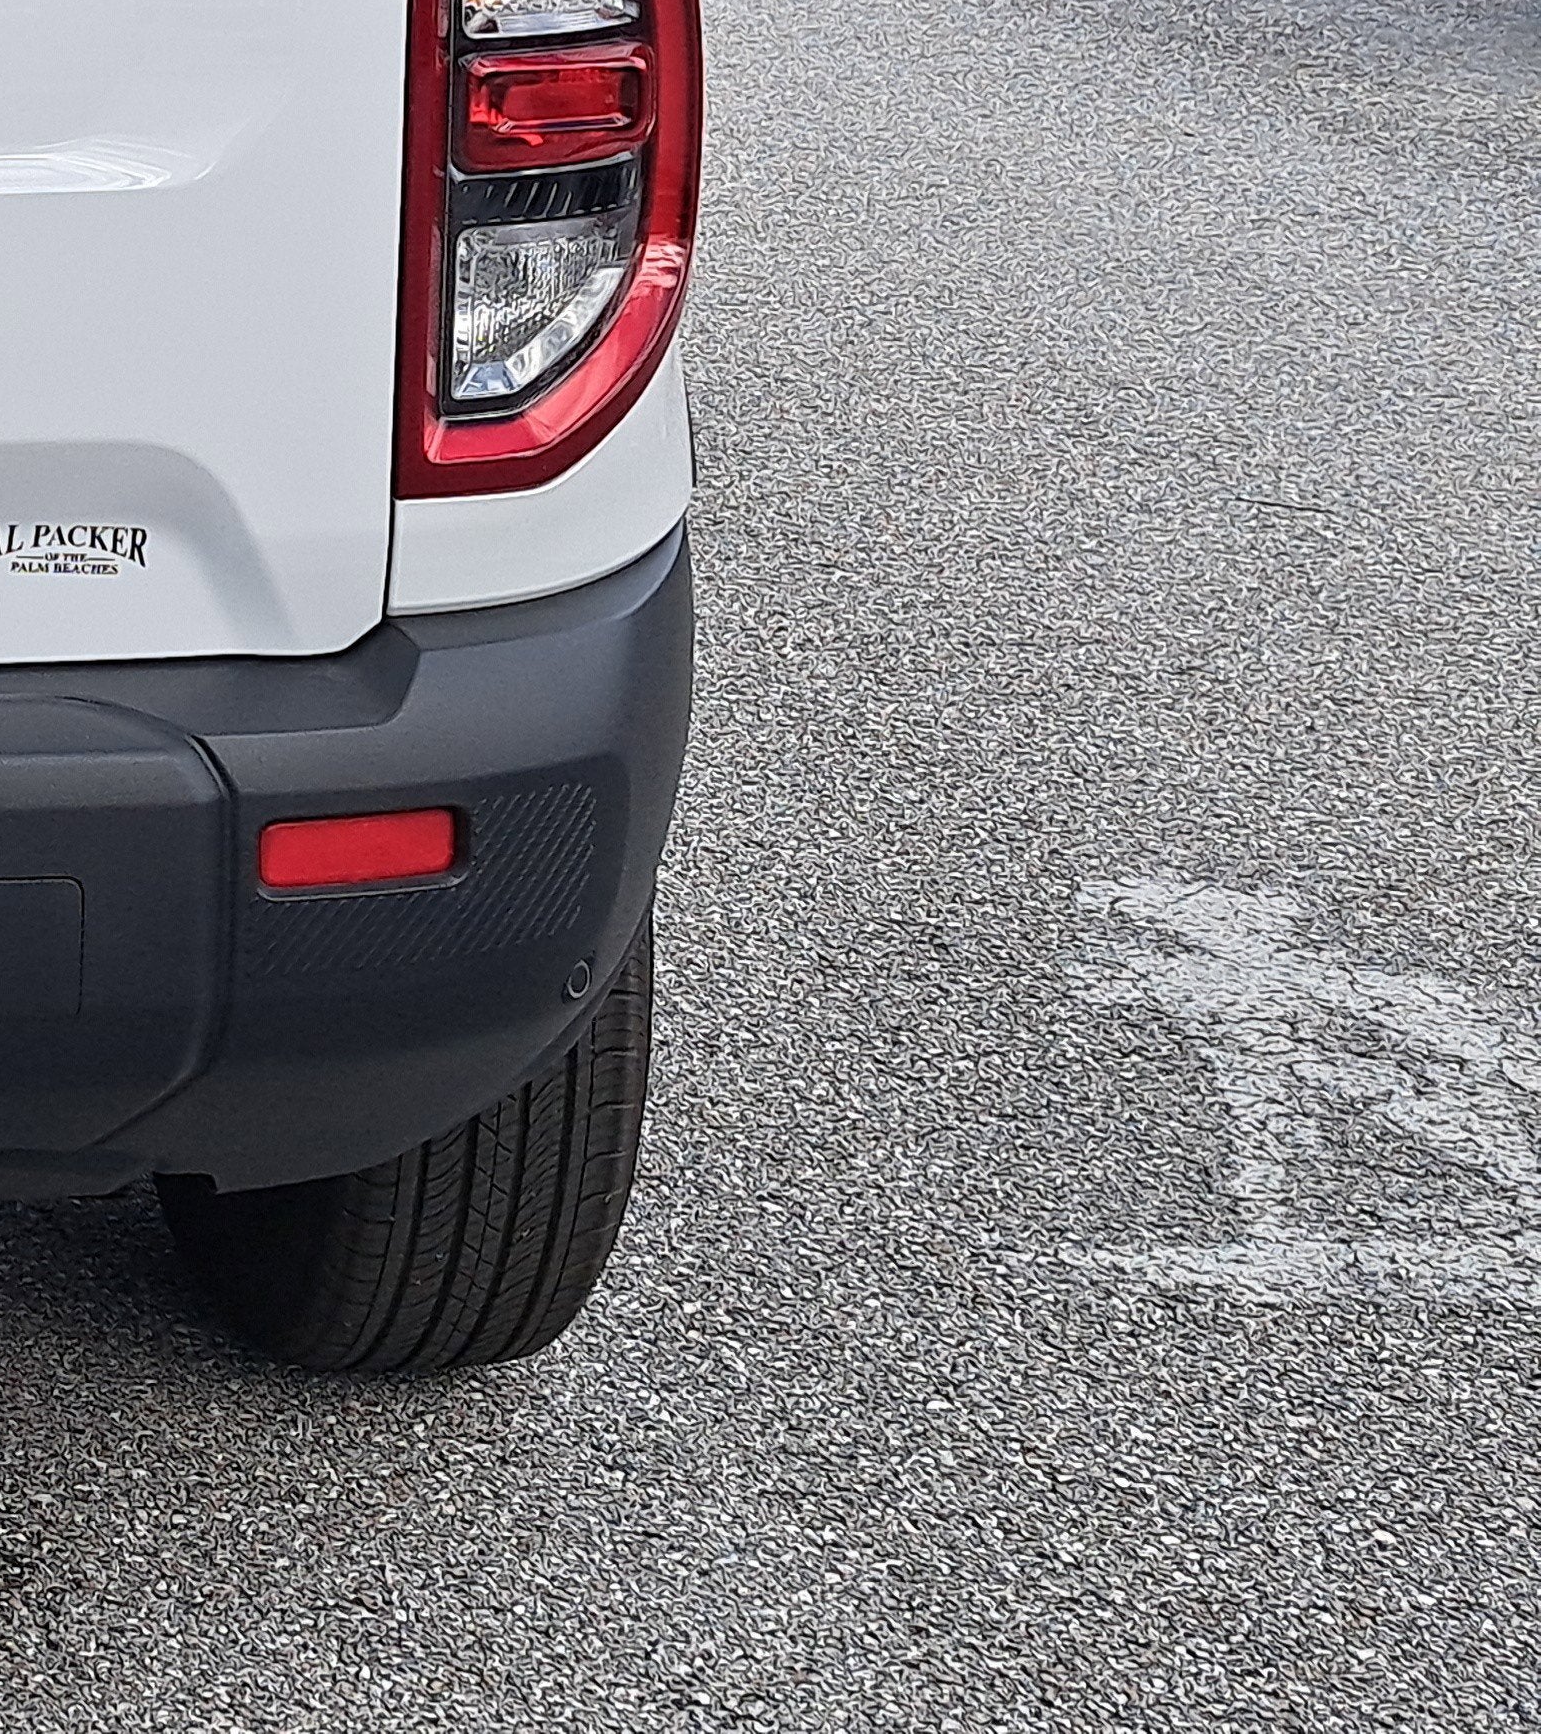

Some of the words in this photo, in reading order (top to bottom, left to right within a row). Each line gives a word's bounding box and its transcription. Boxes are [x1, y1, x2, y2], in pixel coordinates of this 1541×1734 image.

[30, 524, 148, 568] PACKER
[10, 561, 49, 573] PALM
[53, 562, 119, 575] BEACHES
